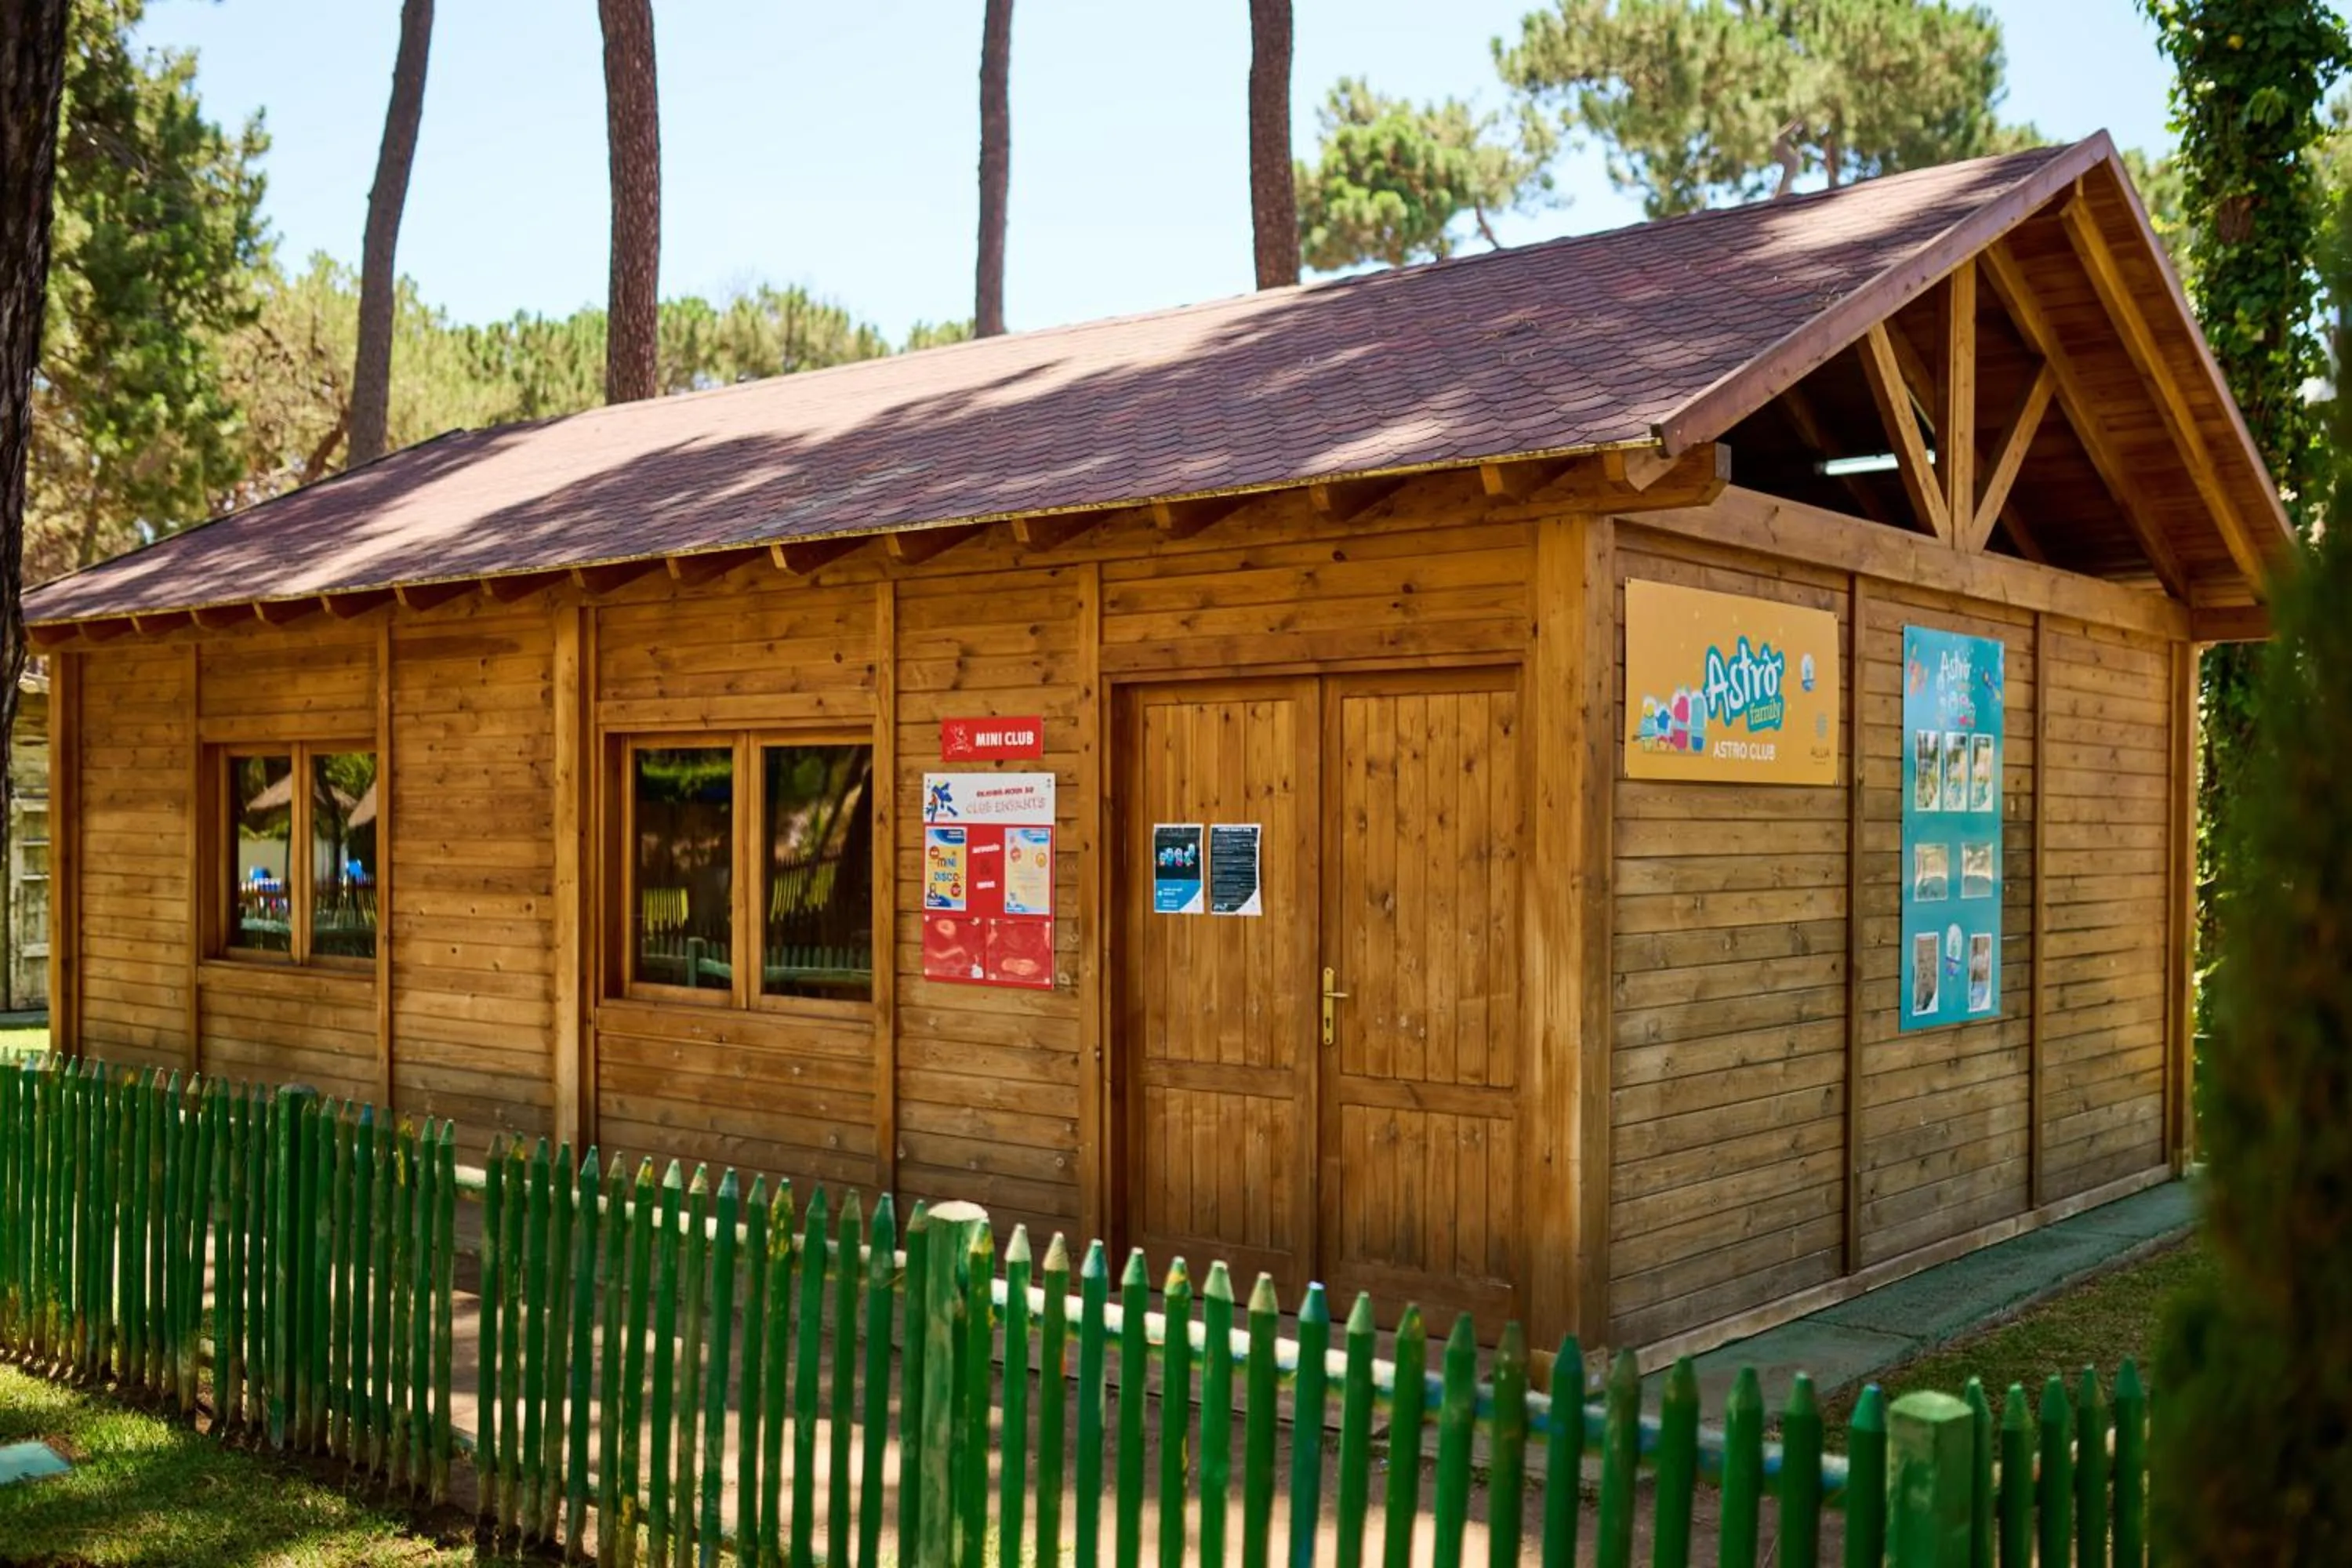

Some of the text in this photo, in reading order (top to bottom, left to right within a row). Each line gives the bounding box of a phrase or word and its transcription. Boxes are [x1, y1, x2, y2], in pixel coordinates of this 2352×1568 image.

[1705, 643, 1782, 720] Astro
[1749, 698, 1781, 726] family
[975, 731, 1034, 747] MINI CLUB
[1713, 741, 1776, 760] ASTRO CLUB
